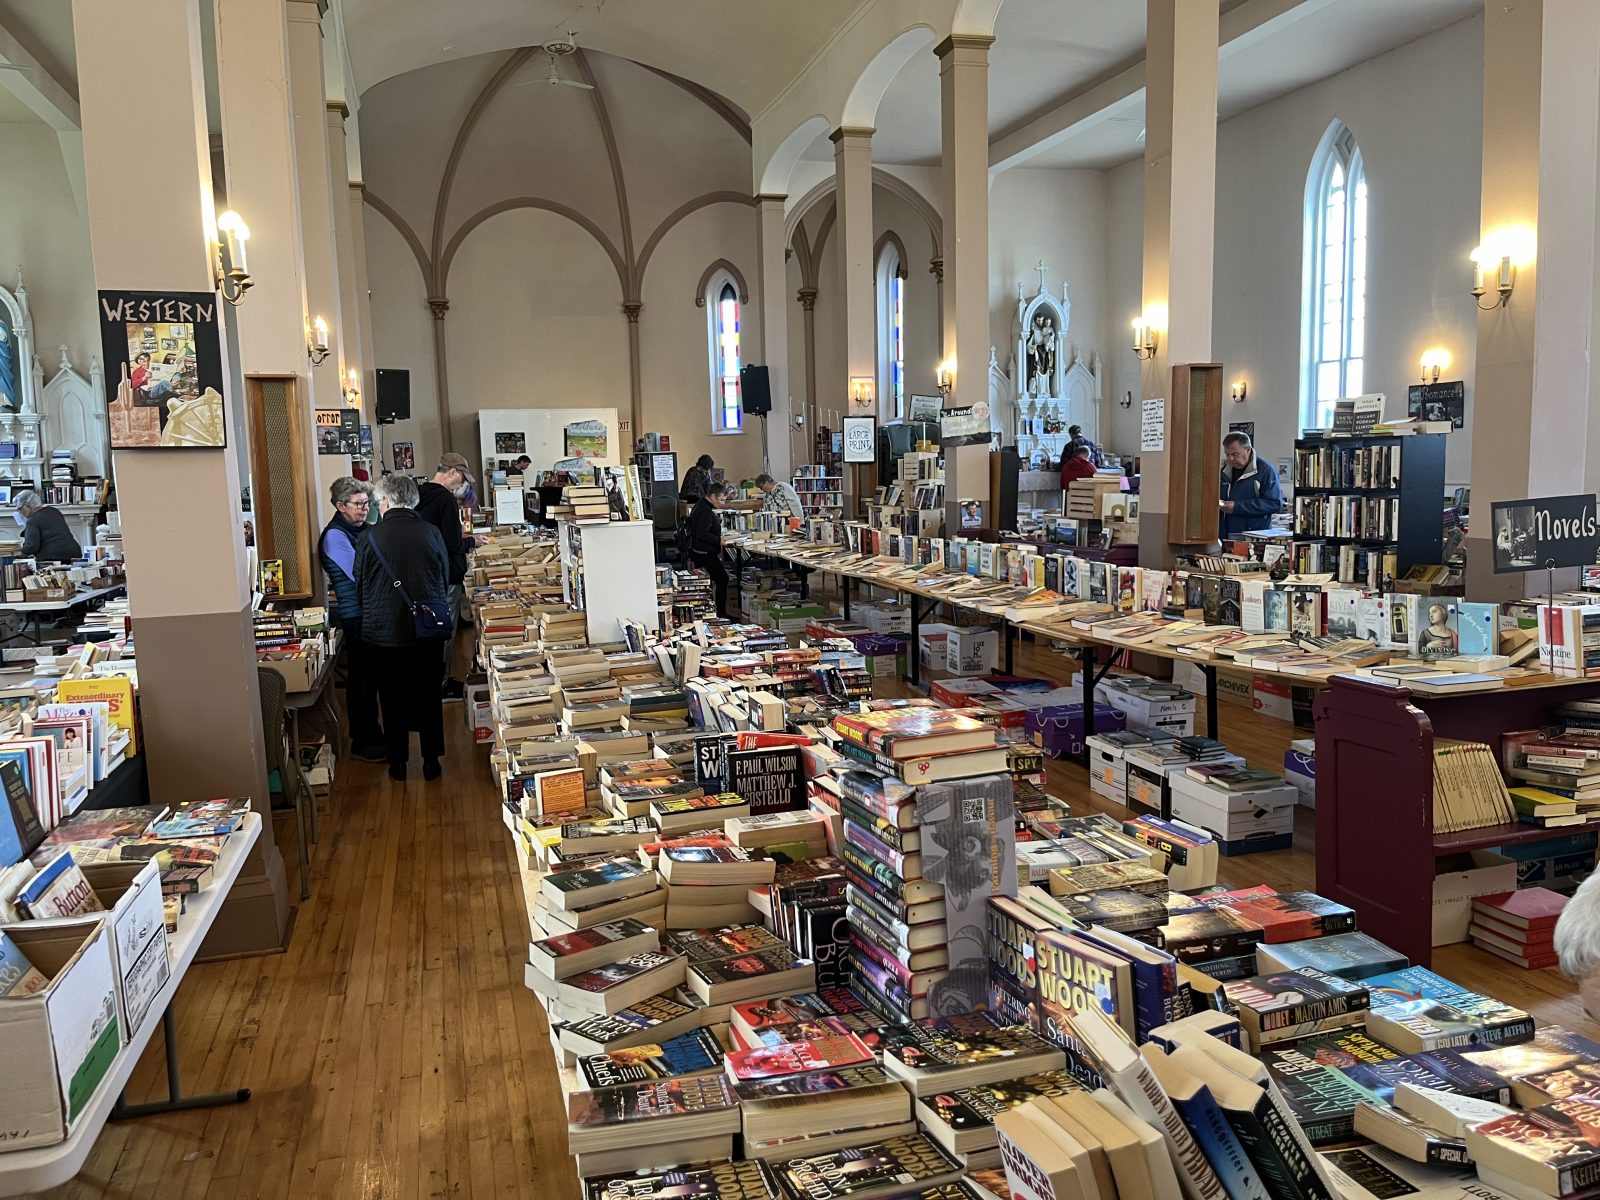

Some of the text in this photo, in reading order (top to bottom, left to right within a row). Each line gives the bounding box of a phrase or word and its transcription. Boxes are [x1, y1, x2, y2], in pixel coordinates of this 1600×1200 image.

[101, 298, 213, 322] WESTERN
[315, 413, 340, 424] orror
[950, 408, 972, 417] Around
[849, 430, 870, 440] LARGE
[848, 440, 872, 450] PRINT
[1535, 505, 1596, 541] Novels
[1217, 679, 1250, 695] ARCHIVEX
[66, 691, 125, 703] Extraordinary
[743, 736, 757, 749] THE
[743, 759, 764, 775] PAUL
[765, 756, 797, 773] WILSON
[1017, 757, 1038, 770] SPY
[736, 772, 797, 793] MATTHEW J.
[744, 788, 791, 807] COSTELLO
[1036, 940, 1114, 990] STUART
[1200, 964, 1229, 972] NOTHING
[1398, 972, 1430, 989] ALWAYS
[1407, 969, 1442, 987] PARROTS
[1264, 996, 1348, 1031] MONEY MARTIN AMIS
[575, 1019, 616, 1042] Work
[594, 1013, 635, 1034] Dirty
[1343, 1033, 1376, 1052] YEARS
[1437, 1034, 1469, 1049] GOLIATH
[1479, 1029, 1502, 1044] STEVE
[589, 1054, 621, 1086] Chiefs
[1271, 1060, 1304, 1076] TED
[1136, 1067, 1169, 1118] WARREN
[1163, 1112, 1188, 1148] ADLER
[1267, 1108, 1280, 1125] THE
[1276, 1124, 1301, 1161] PURITY
[1305, 1124, 1334, 1140] RTBEAT
[881, 1137, 932, 1179] WOODS
[901, 1133, 957, 1175] STUART
[996, 1130, 1052, 1188] GLOVER
[1440, 1148, 1462, 1162] SPECIAL
[731, 1159, 769, 1200] STUAR
[788, 1157, 833, 1200] ORCHID
[814, 1157, 847, 1189] IRON
